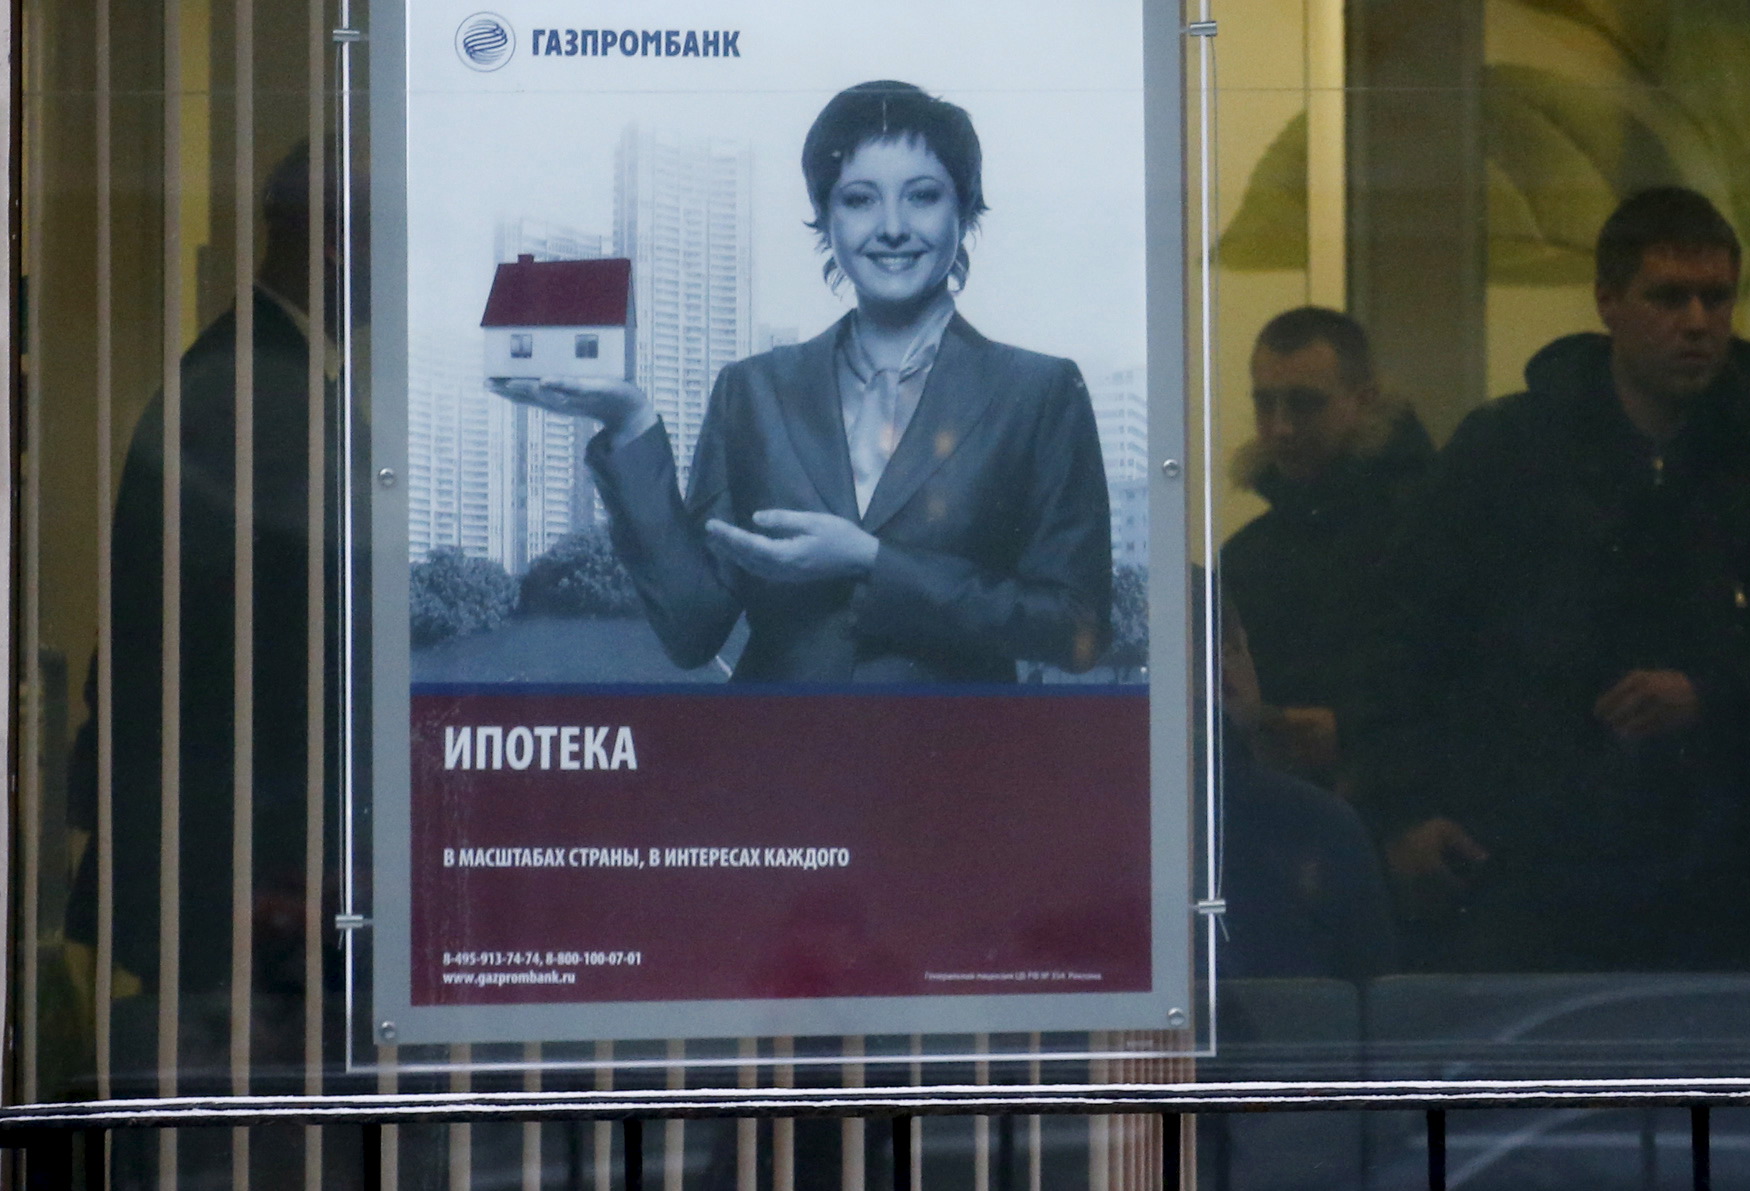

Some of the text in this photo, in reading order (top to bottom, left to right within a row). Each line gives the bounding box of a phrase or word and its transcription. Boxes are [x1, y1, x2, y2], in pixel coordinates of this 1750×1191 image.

[532, 29, 741, 58] ГАЗПРОМБАНК
[444, 726, 638, 770] ИПОТЕКА
[443, 847, 850, 871] В МАСШТАБАХ СТРАНЫ, В ИНТЕРЕСАХ КАЖДОГО
[442, 951, 642, 968] 8-495-913-74-74, 8-800-100-07-01
[442, 969, 576, 988] www.gazprombank.ru
